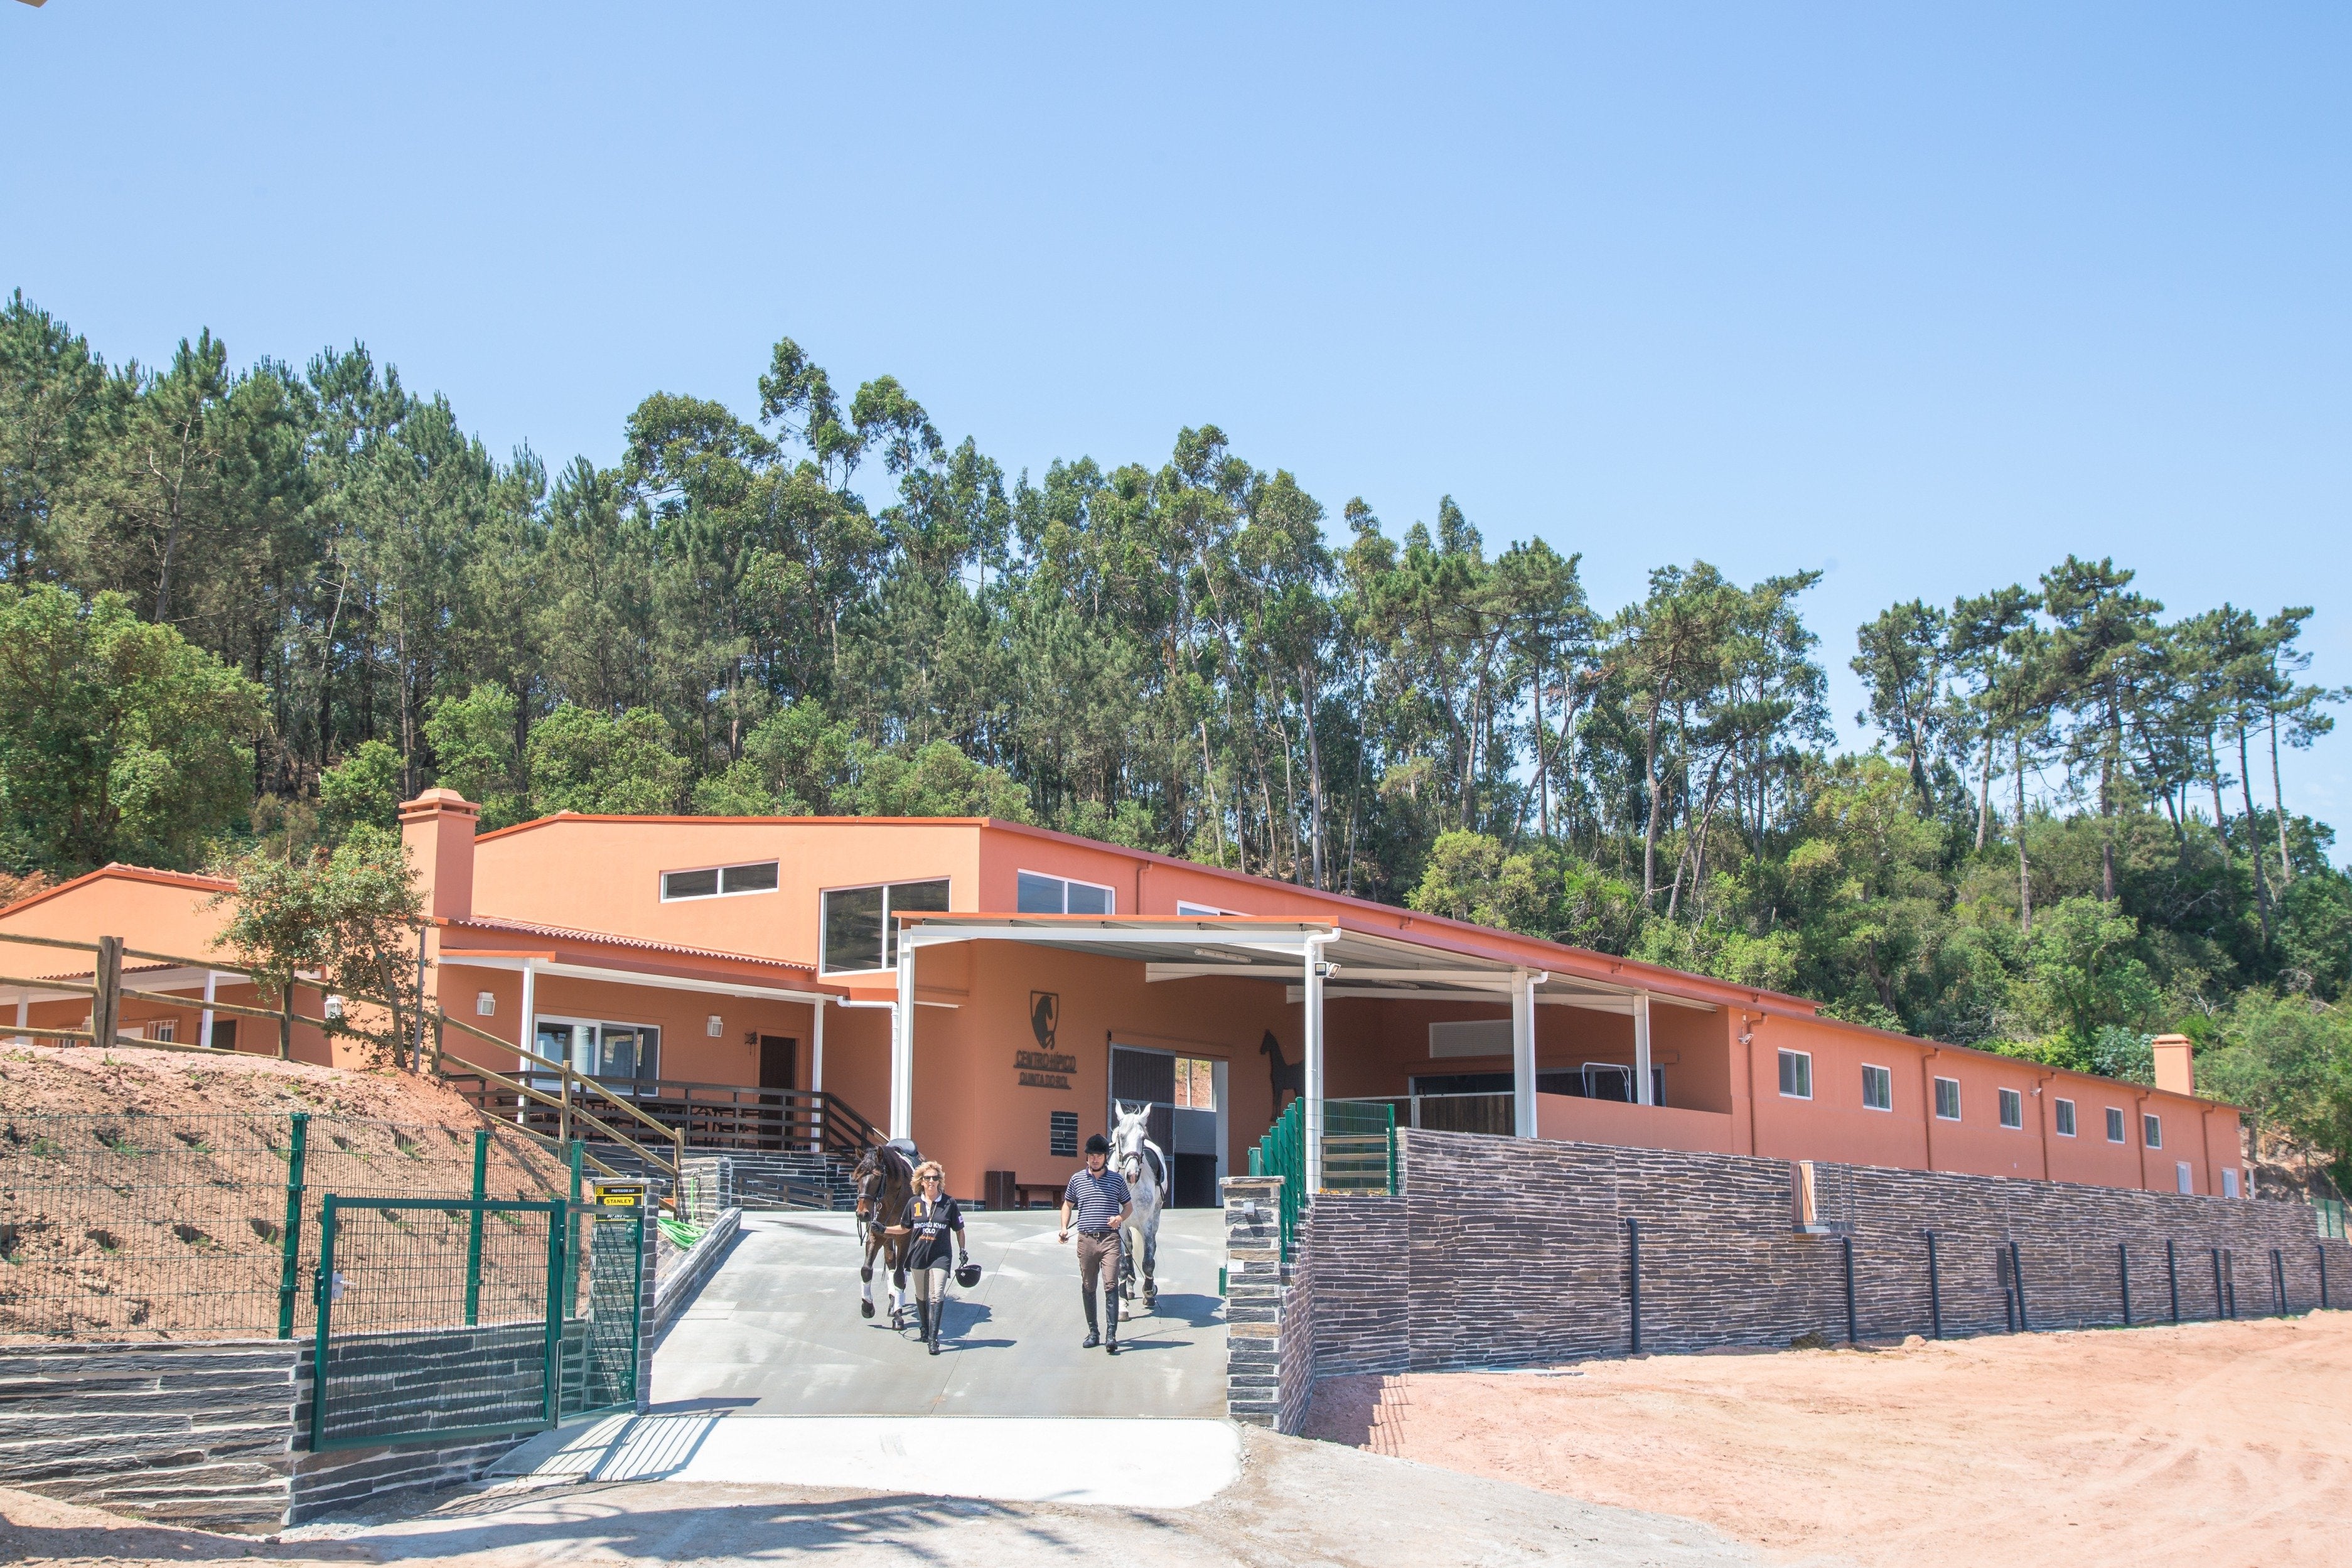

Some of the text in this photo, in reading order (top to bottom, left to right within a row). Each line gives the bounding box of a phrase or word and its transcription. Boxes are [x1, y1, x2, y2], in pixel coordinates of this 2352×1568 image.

[1016, 1050, 1049, 1069] CENTRO
[1020, 1072, 1044, 1085] QUINTA
[914, 1202, 922, 1216] 1
